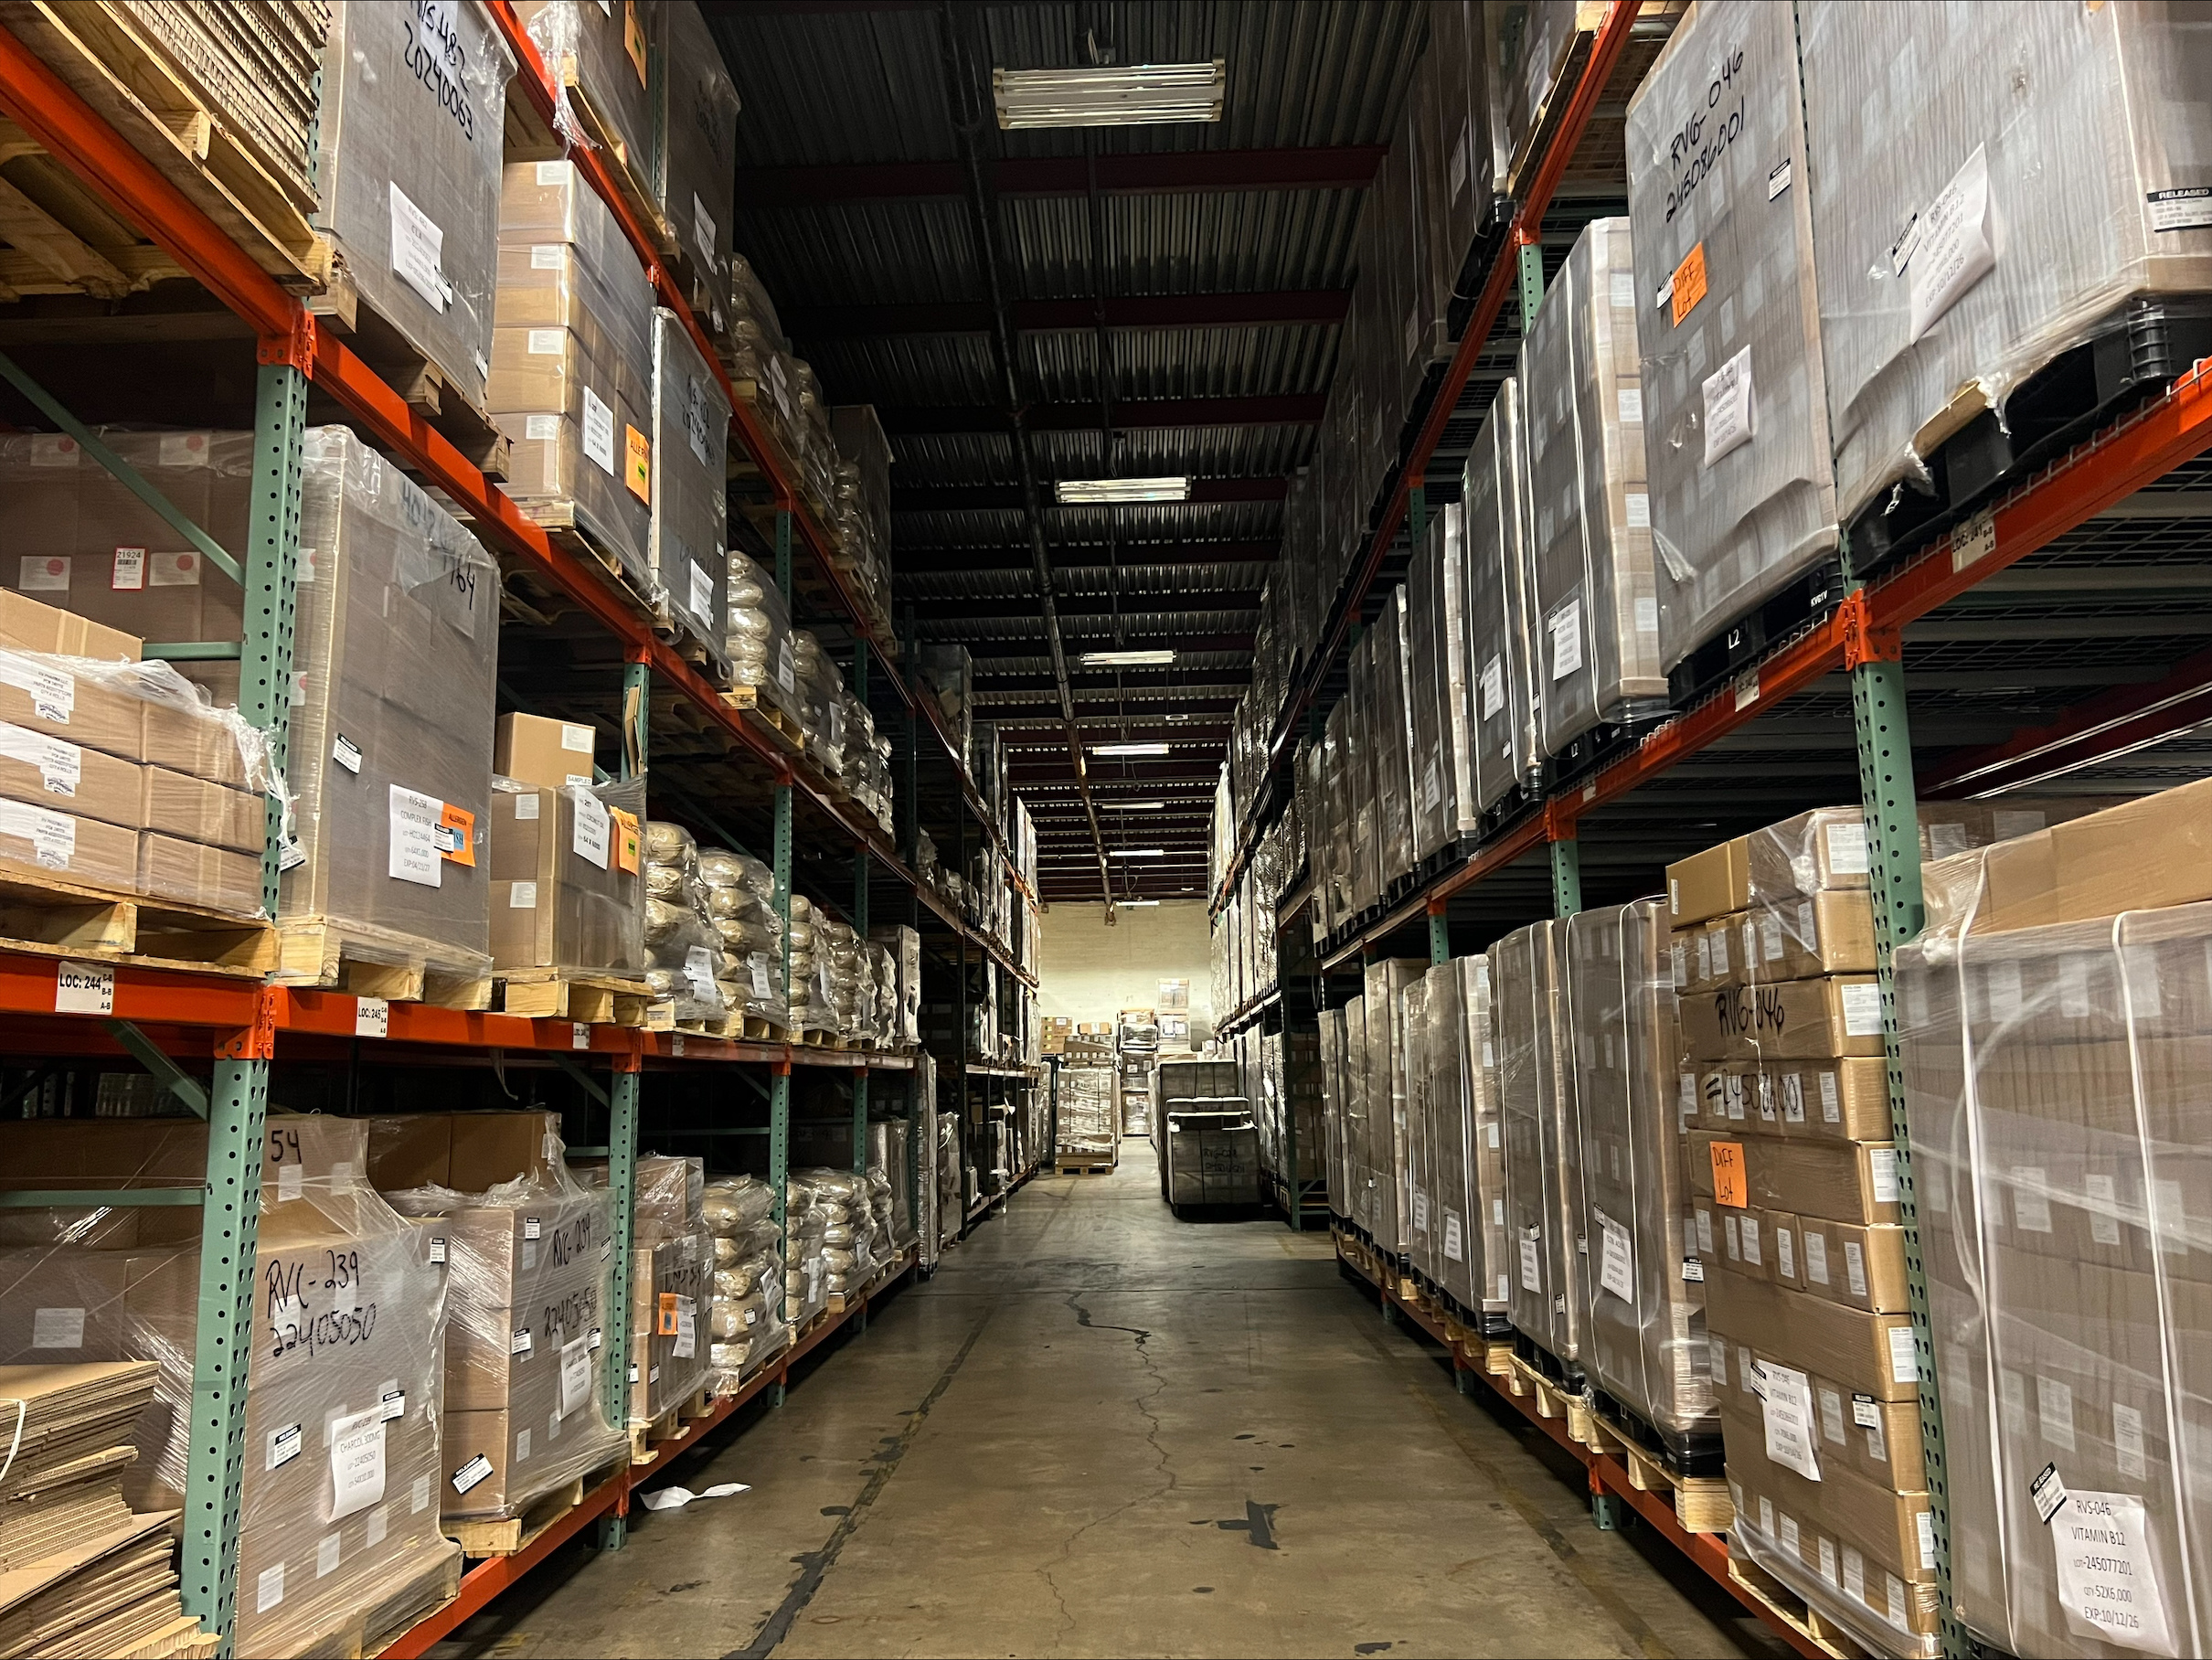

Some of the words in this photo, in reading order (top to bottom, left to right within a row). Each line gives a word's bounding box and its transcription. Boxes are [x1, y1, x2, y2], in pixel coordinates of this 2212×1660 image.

[2158, 188, 2209, 199] RELEASED
[1673, 261, 1694, 292] DIFF
[1728, 629, 1740, 650] L2
[453, 831, 464, 846] ISH
[59, 974, 82, 988] LOC:
[84, 975, 102, 990] 244
[371, 1008, 381, 1019] 245
[271, 1129, 303, 1164] 54
[1712, 1147, 1733, 1167] DIFF
[270, 1303, 377, 1357] 22405050
[2077, 1500, 2111, 1516] RVS-046
[2071, 1527, 2109, 1544] VITAMIN
[2110, 1531, 2126, 1546] B12
[2085, 1606, 2139, 1628] EXP:10/12/26
